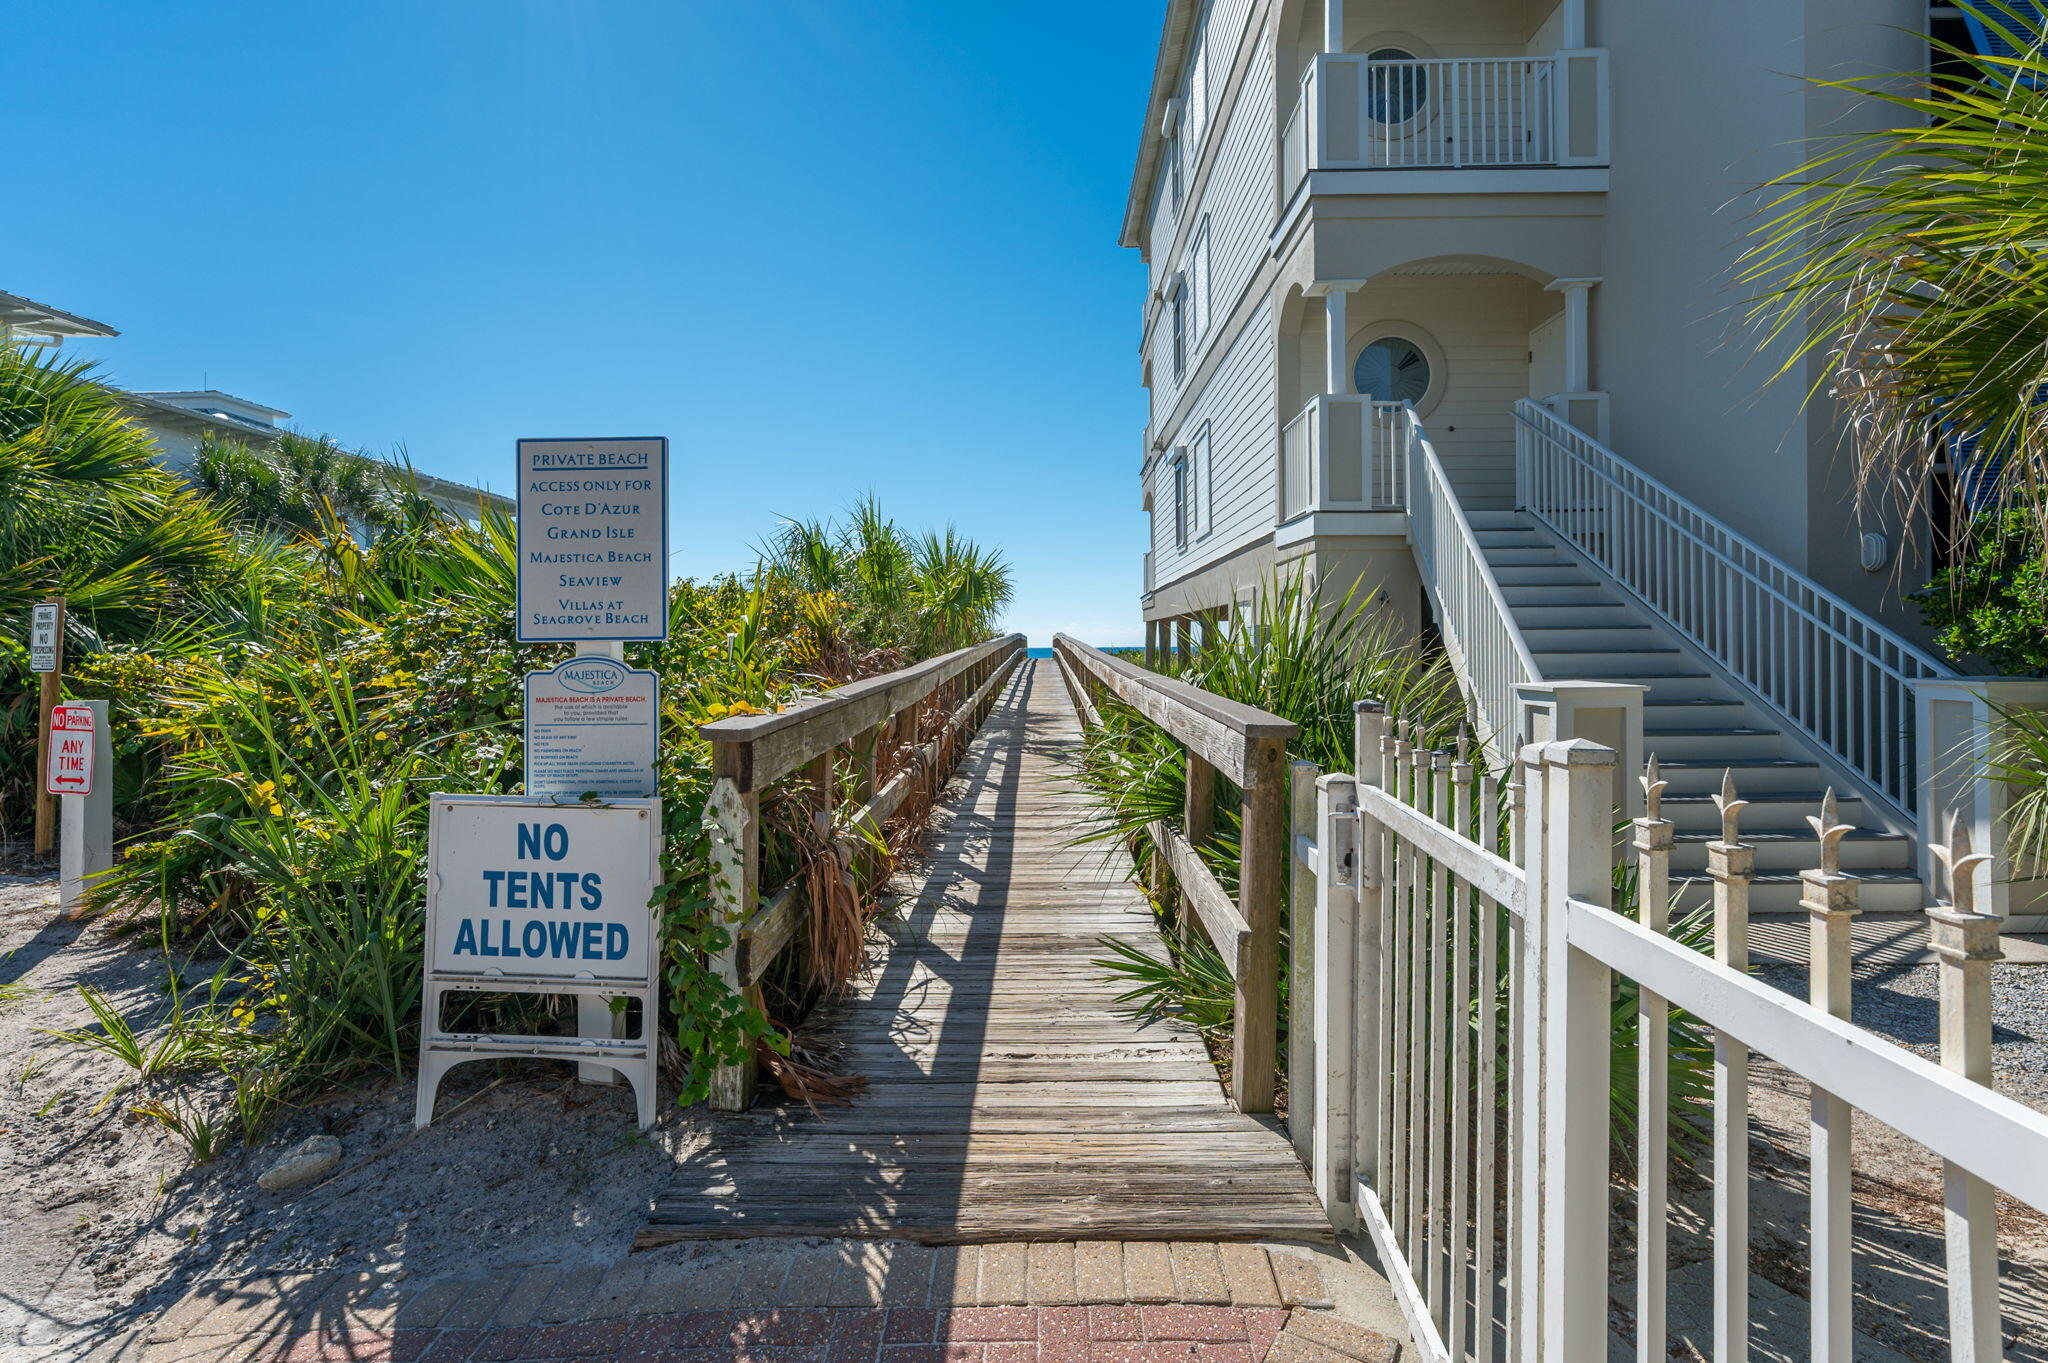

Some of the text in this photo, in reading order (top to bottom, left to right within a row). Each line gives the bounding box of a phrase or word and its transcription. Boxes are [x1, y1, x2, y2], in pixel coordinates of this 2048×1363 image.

[533, 453, 648, 466] PRIVATE BEACH
[530, 480, 651, 492] ACCESS ONLY FOR
[38, 612, 52, 620] PRIVATE
[36, 622, 54, 630] PROPERTY
[40, 634, 49, 644] NO
[564, 670, 618, 680] MAJESTICA
[53, 713, 92, 727] NO PARKING
[62, 740, 84, 754] ANY
[59, 757, 85, 771] TIME
[518, 823, 569, 861] NO
[483, 871, 602, 911] TENTS
[453, 919, 629, 961] ALLOWED
